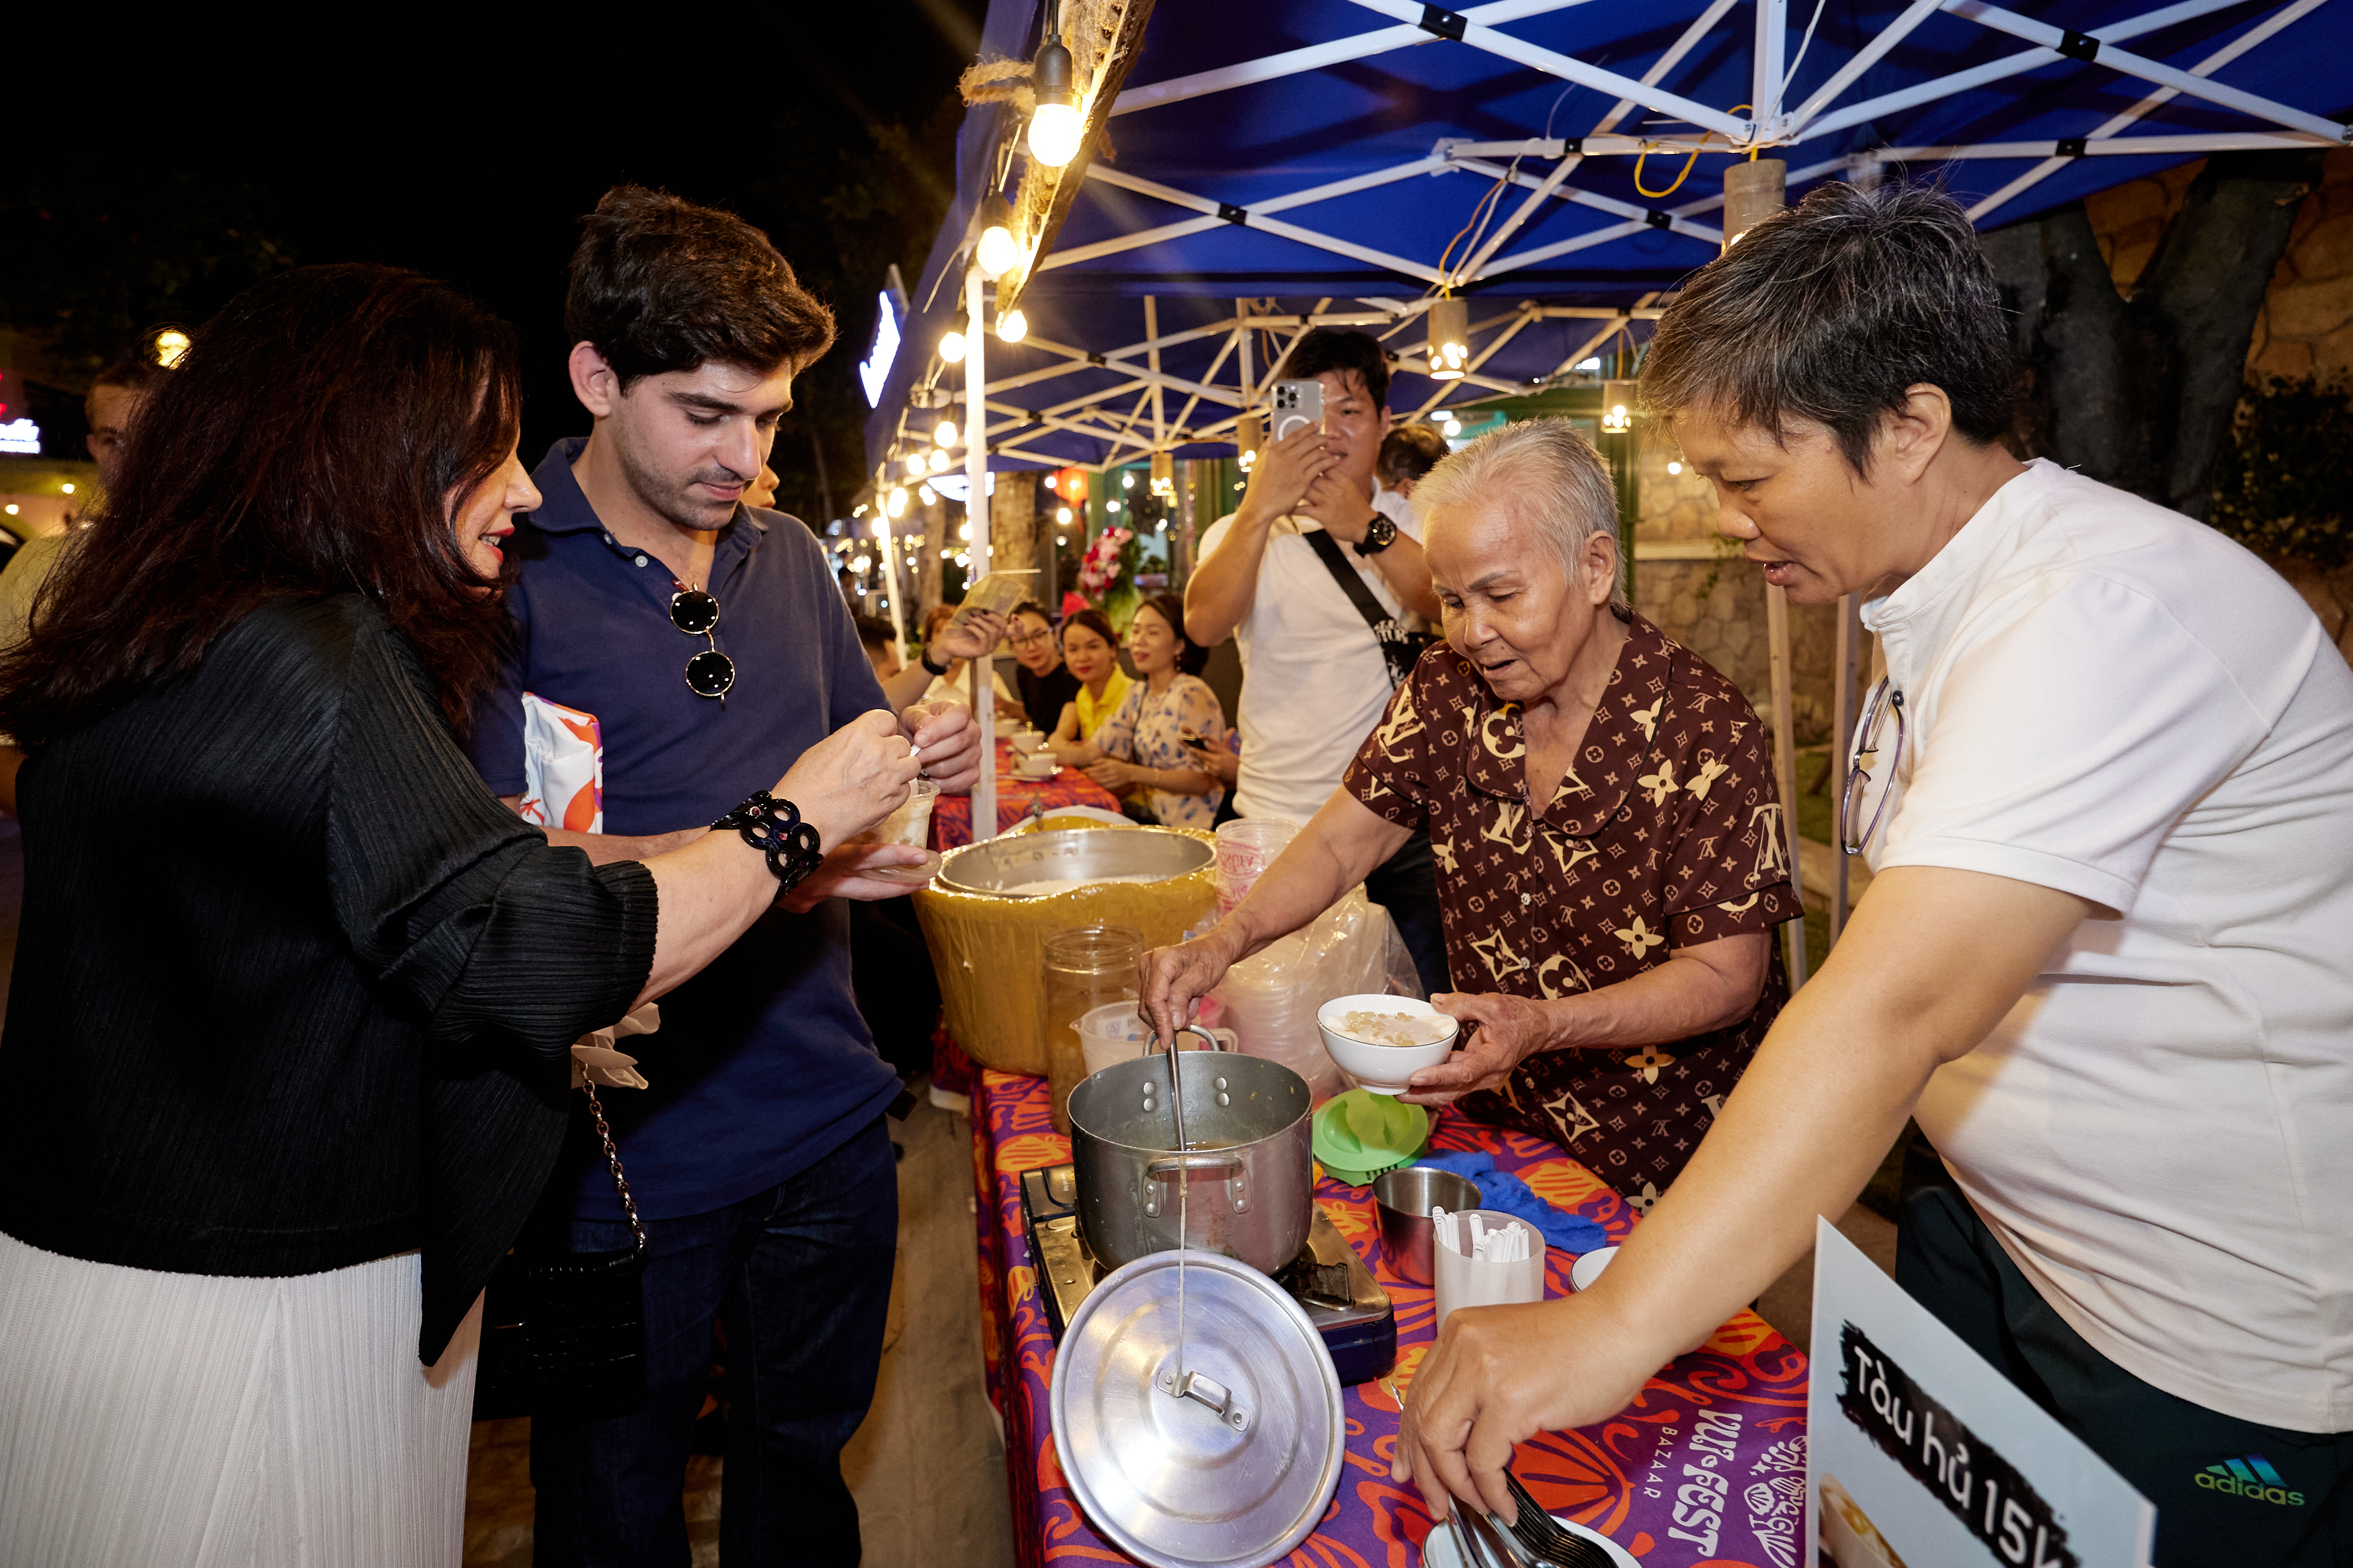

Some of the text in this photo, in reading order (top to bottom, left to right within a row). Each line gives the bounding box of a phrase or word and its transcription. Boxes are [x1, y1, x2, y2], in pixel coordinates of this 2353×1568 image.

[1643, 1426, 1679, 1499] BAZAAR
[1853, 1346, 1914, 1446] Tàu
[1923, 1411, 1973, 1510] hủ
[1668, 1463, 1729, 1557] FEST
[2194, 1473, 2305, 1506] adidas
